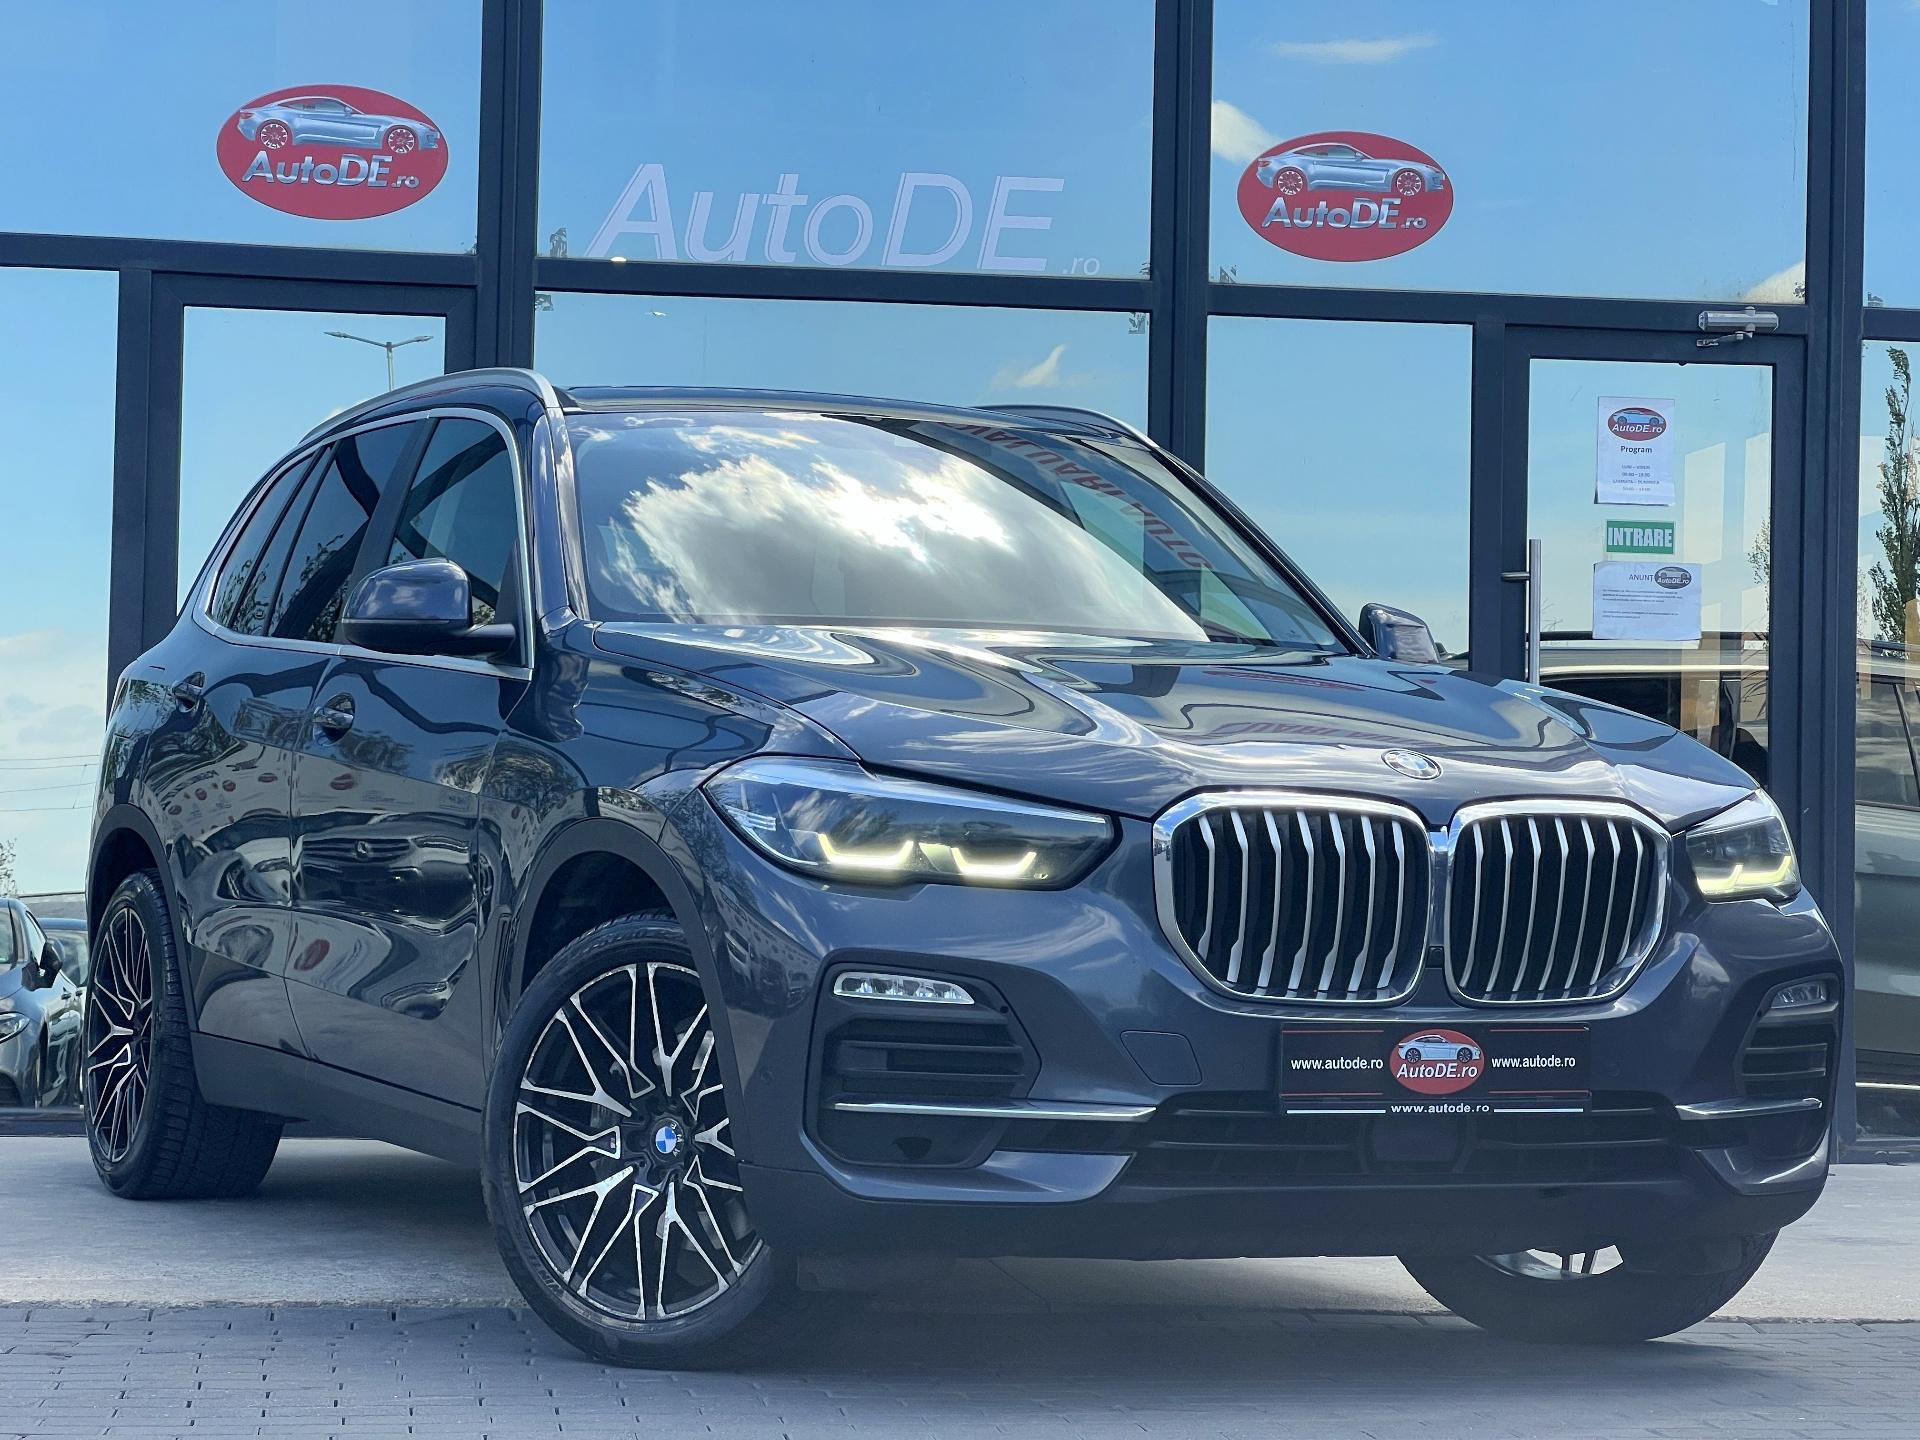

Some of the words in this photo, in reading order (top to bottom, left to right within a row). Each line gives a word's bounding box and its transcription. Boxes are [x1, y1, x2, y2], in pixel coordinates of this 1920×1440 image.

[1612, 423, 1662, 433] AutoDE.ro
[1620, 445, 1653, 454] Program
[1607, 527, 1672, 548] INTRARE
[1290, 1056, 1383, 1070] www.autode.ro
[1491, 1055, 1576, 1068] www.autode.ro
[1396, 1062, 1478, 1079] AutoDE.ro
[1391, 1102, 1490, 1113] www.autode.ro
